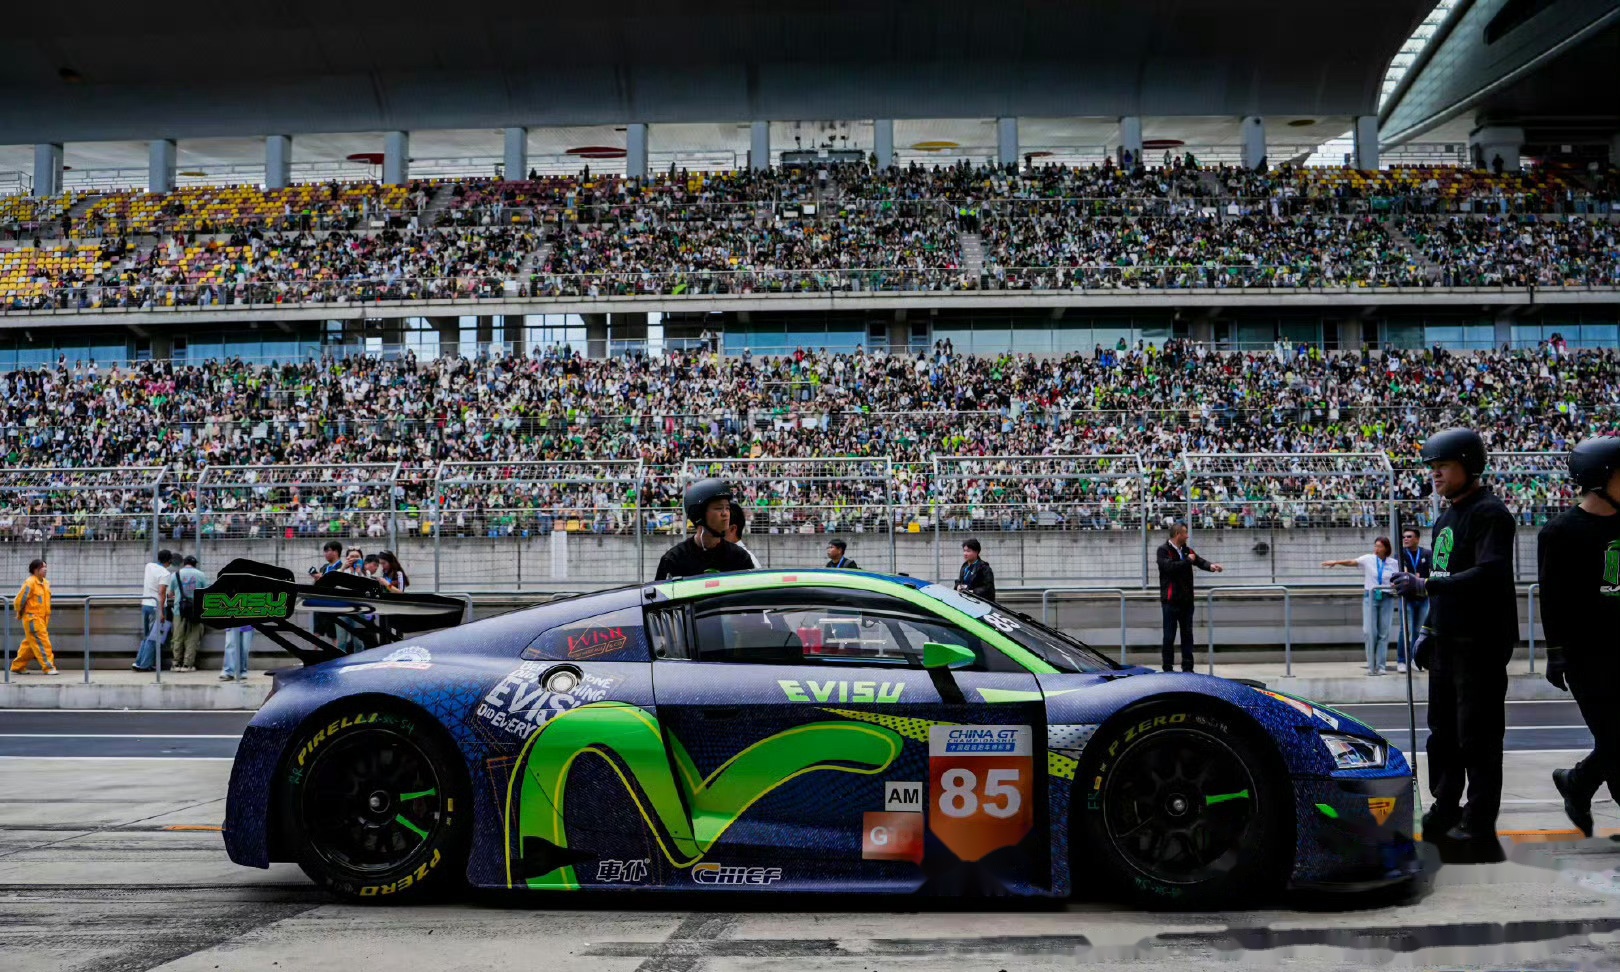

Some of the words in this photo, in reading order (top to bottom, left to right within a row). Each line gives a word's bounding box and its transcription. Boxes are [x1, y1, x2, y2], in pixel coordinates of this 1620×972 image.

[203, 592, 288, 607] EVISU
[225, 607, 287, 618] RACING
[983, 612, 1021, 633] 85
[581, 672, 614, 690] YONE
[777, 679, 906, 704] EVISU
[484, 676, 582, 727] EVIS
[568, 683, 607, 701] HING
[949, 729, 994, 739] CHINA
[997, 729, 1019, 739] GT
[1124, 713, 1187, 743] ZERO
[297, 712, 379, 766] PIRELLI
[888, 788, 919, 804] AM
[938, 768, 1021, 819] 85
[691, 862, 782, 885] CHIEF
